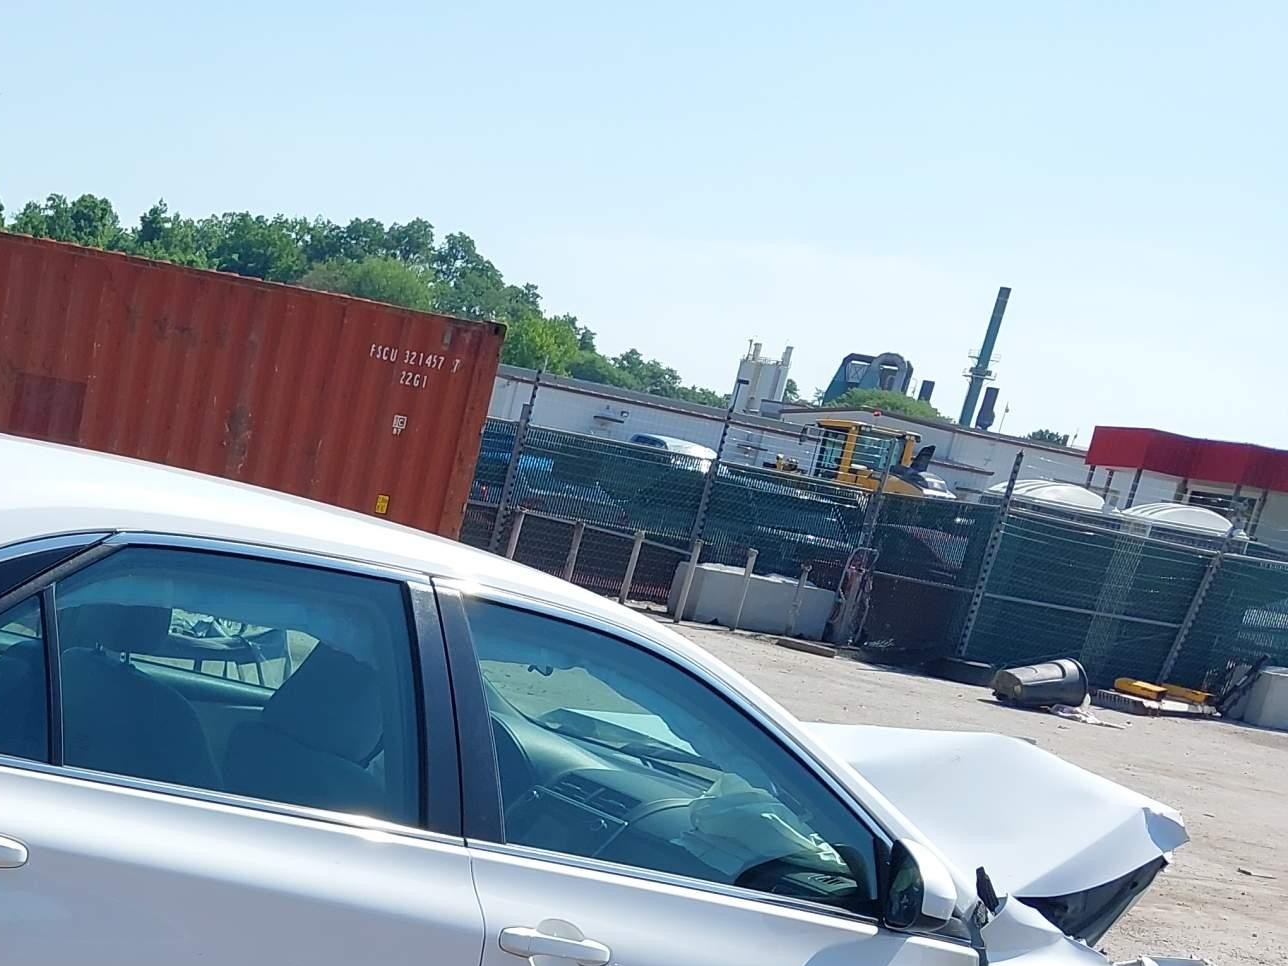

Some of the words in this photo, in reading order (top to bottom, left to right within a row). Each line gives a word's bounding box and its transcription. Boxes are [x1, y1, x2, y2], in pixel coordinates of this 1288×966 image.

[369, 343, 399, 362] FSCU
[404, 350, 444, 370] 321457
[399, 371, 428, 389] 22G1
